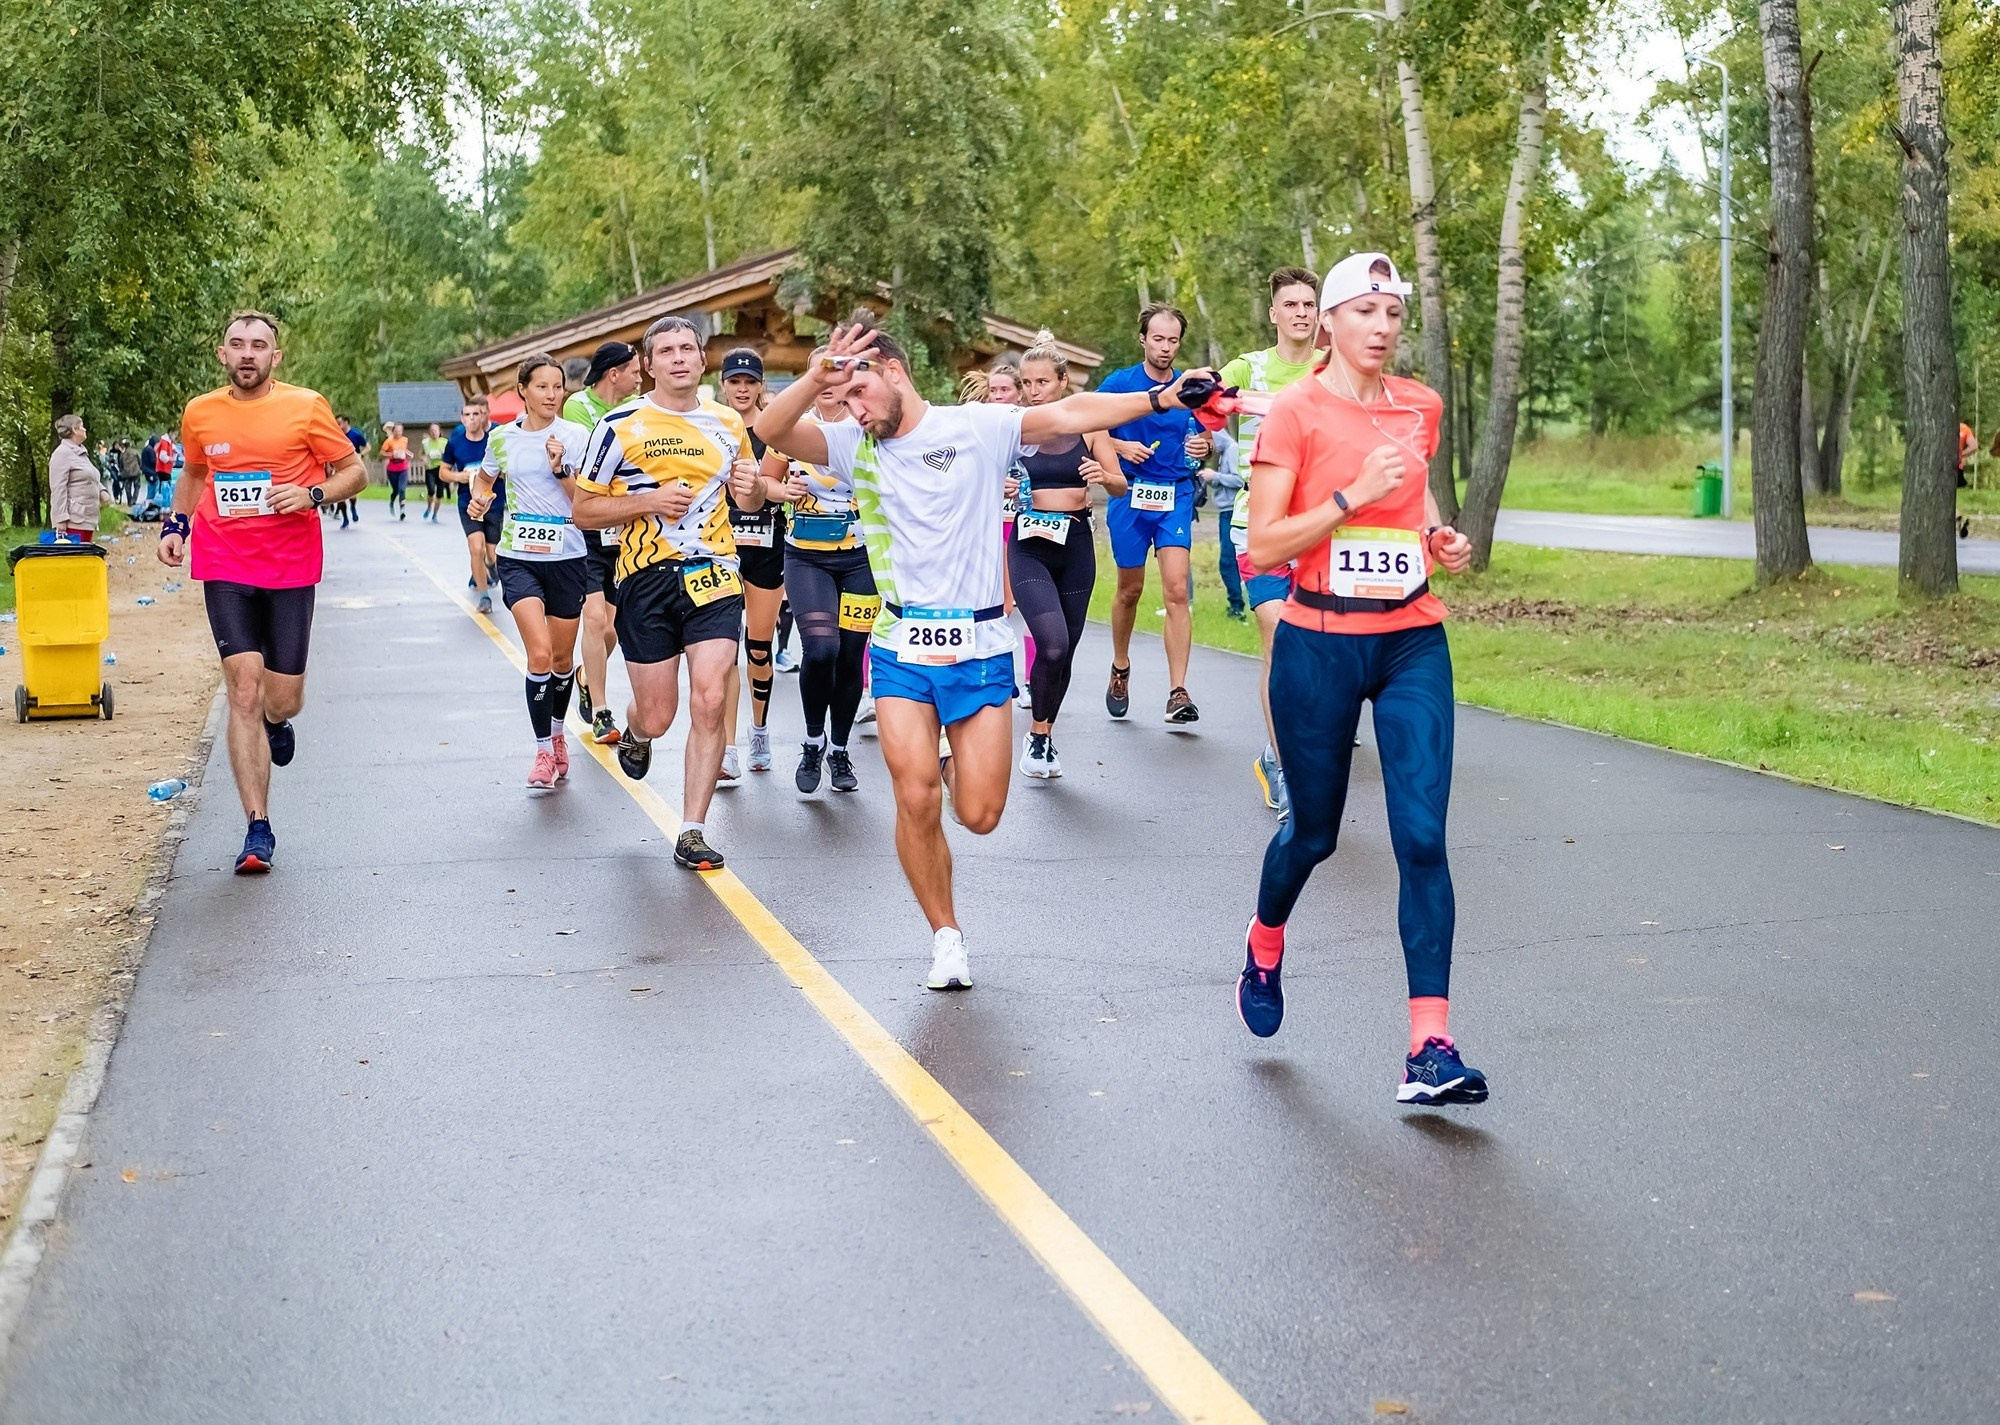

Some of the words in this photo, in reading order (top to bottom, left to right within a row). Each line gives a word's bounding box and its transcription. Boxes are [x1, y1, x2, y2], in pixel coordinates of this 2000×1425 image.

[643, 438, 684, 450] ЛИДЕР
[645, 448, 704, 459] КОМАНДЫ
[220, 487, 262, 502] 2617
[1136, 488, 1168, 501] 2808
[733, 525, 766, 535] 311
[1023, 517, 1061, 530] 2499
[518, 527, 556, 541] 2282
[1338, 549, 1409, 575] 1136
[909, 627, 962, 646] 2868
